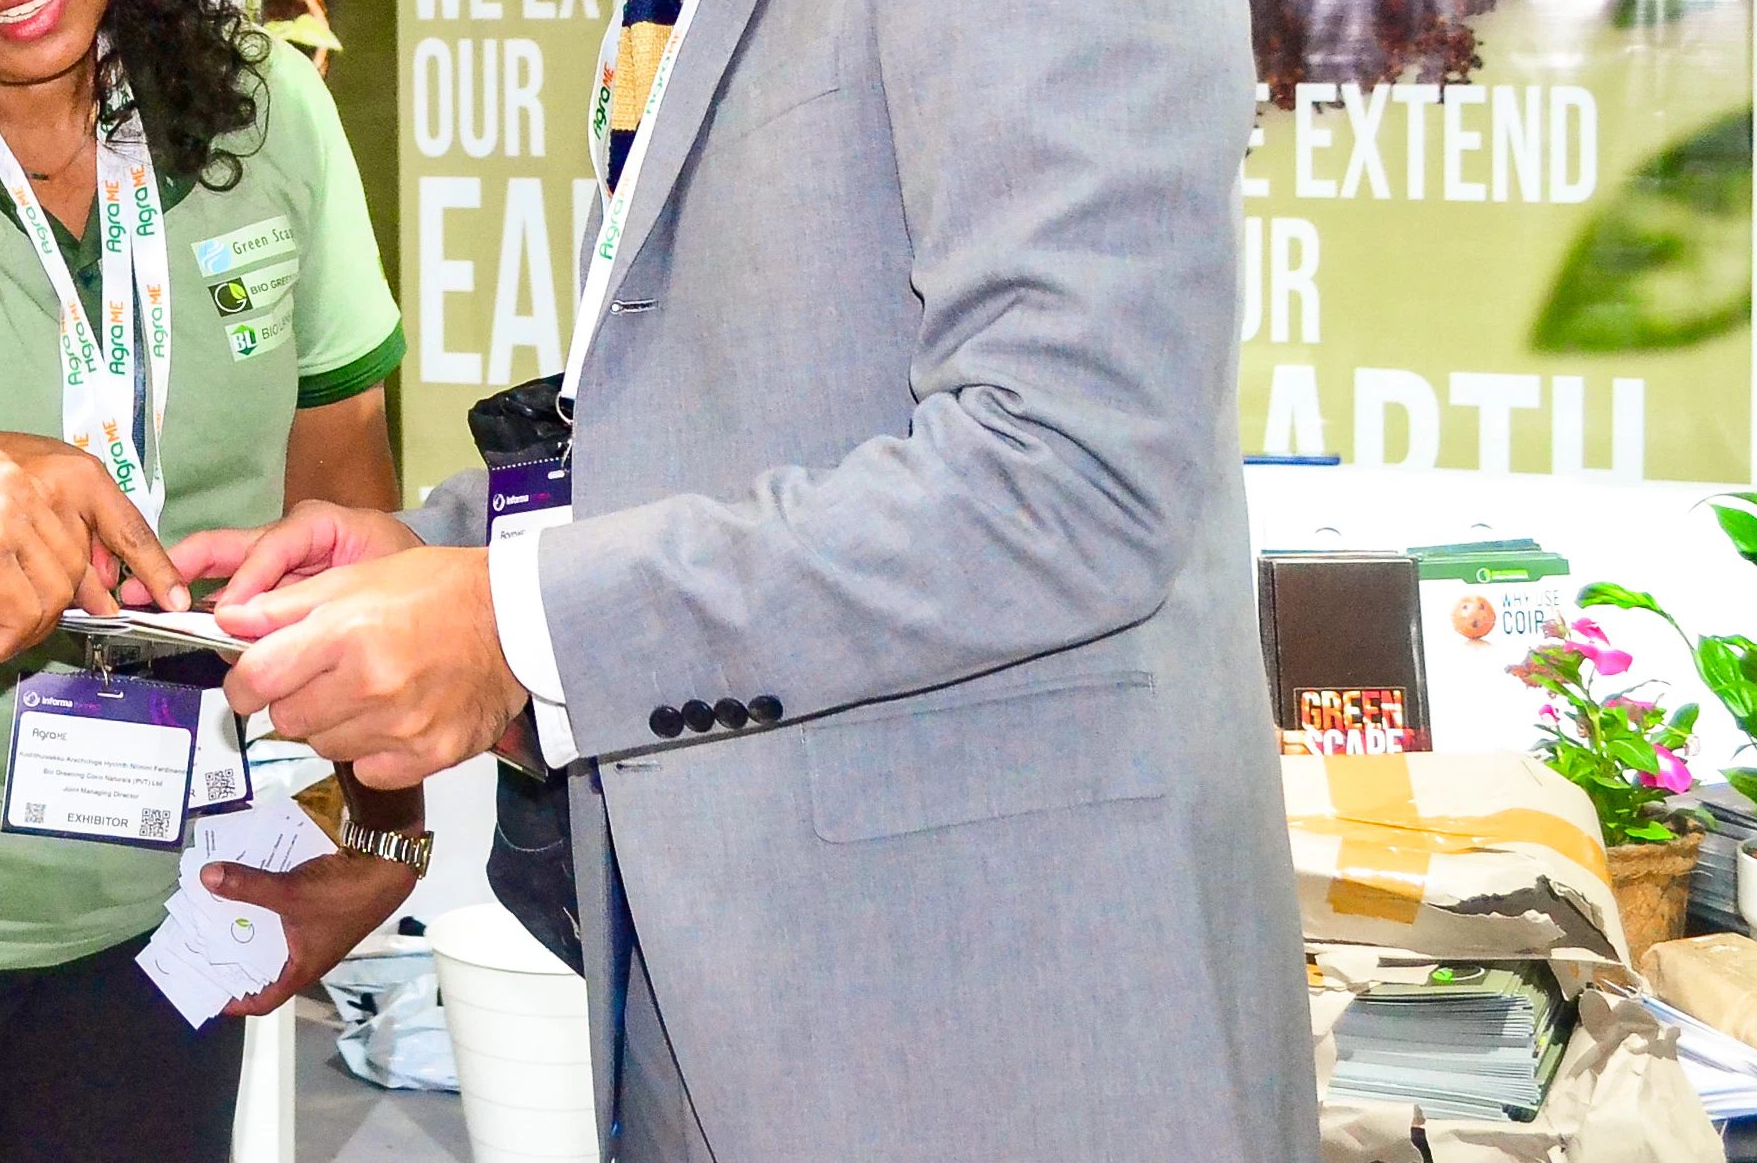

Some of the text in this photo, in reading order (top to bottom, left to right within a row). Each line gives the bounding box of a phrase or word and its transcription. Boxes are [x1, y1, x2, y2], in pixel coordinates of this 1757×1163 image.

[413, 37, 546, 157] OUR
[1294, 82, 1598, 203] EXTEND
[12, 185, 53, 254] AgraME
[105, 180, 126, 253] AgraME
[131, 165, 158, 236] AgraME
[233, 236, 269, 255] Green
[418, 176, 599, 385] EA
[147, 283, 168, 358] AgraME
[250, 282, 268, 295] BIO
[109, 300, 131, 375] AgraME
[102, 417, 136, 493] AgraME
[1301, 689, 1404, 730] GREEN
[67, 812, 129, 828] EXHIBITOR
